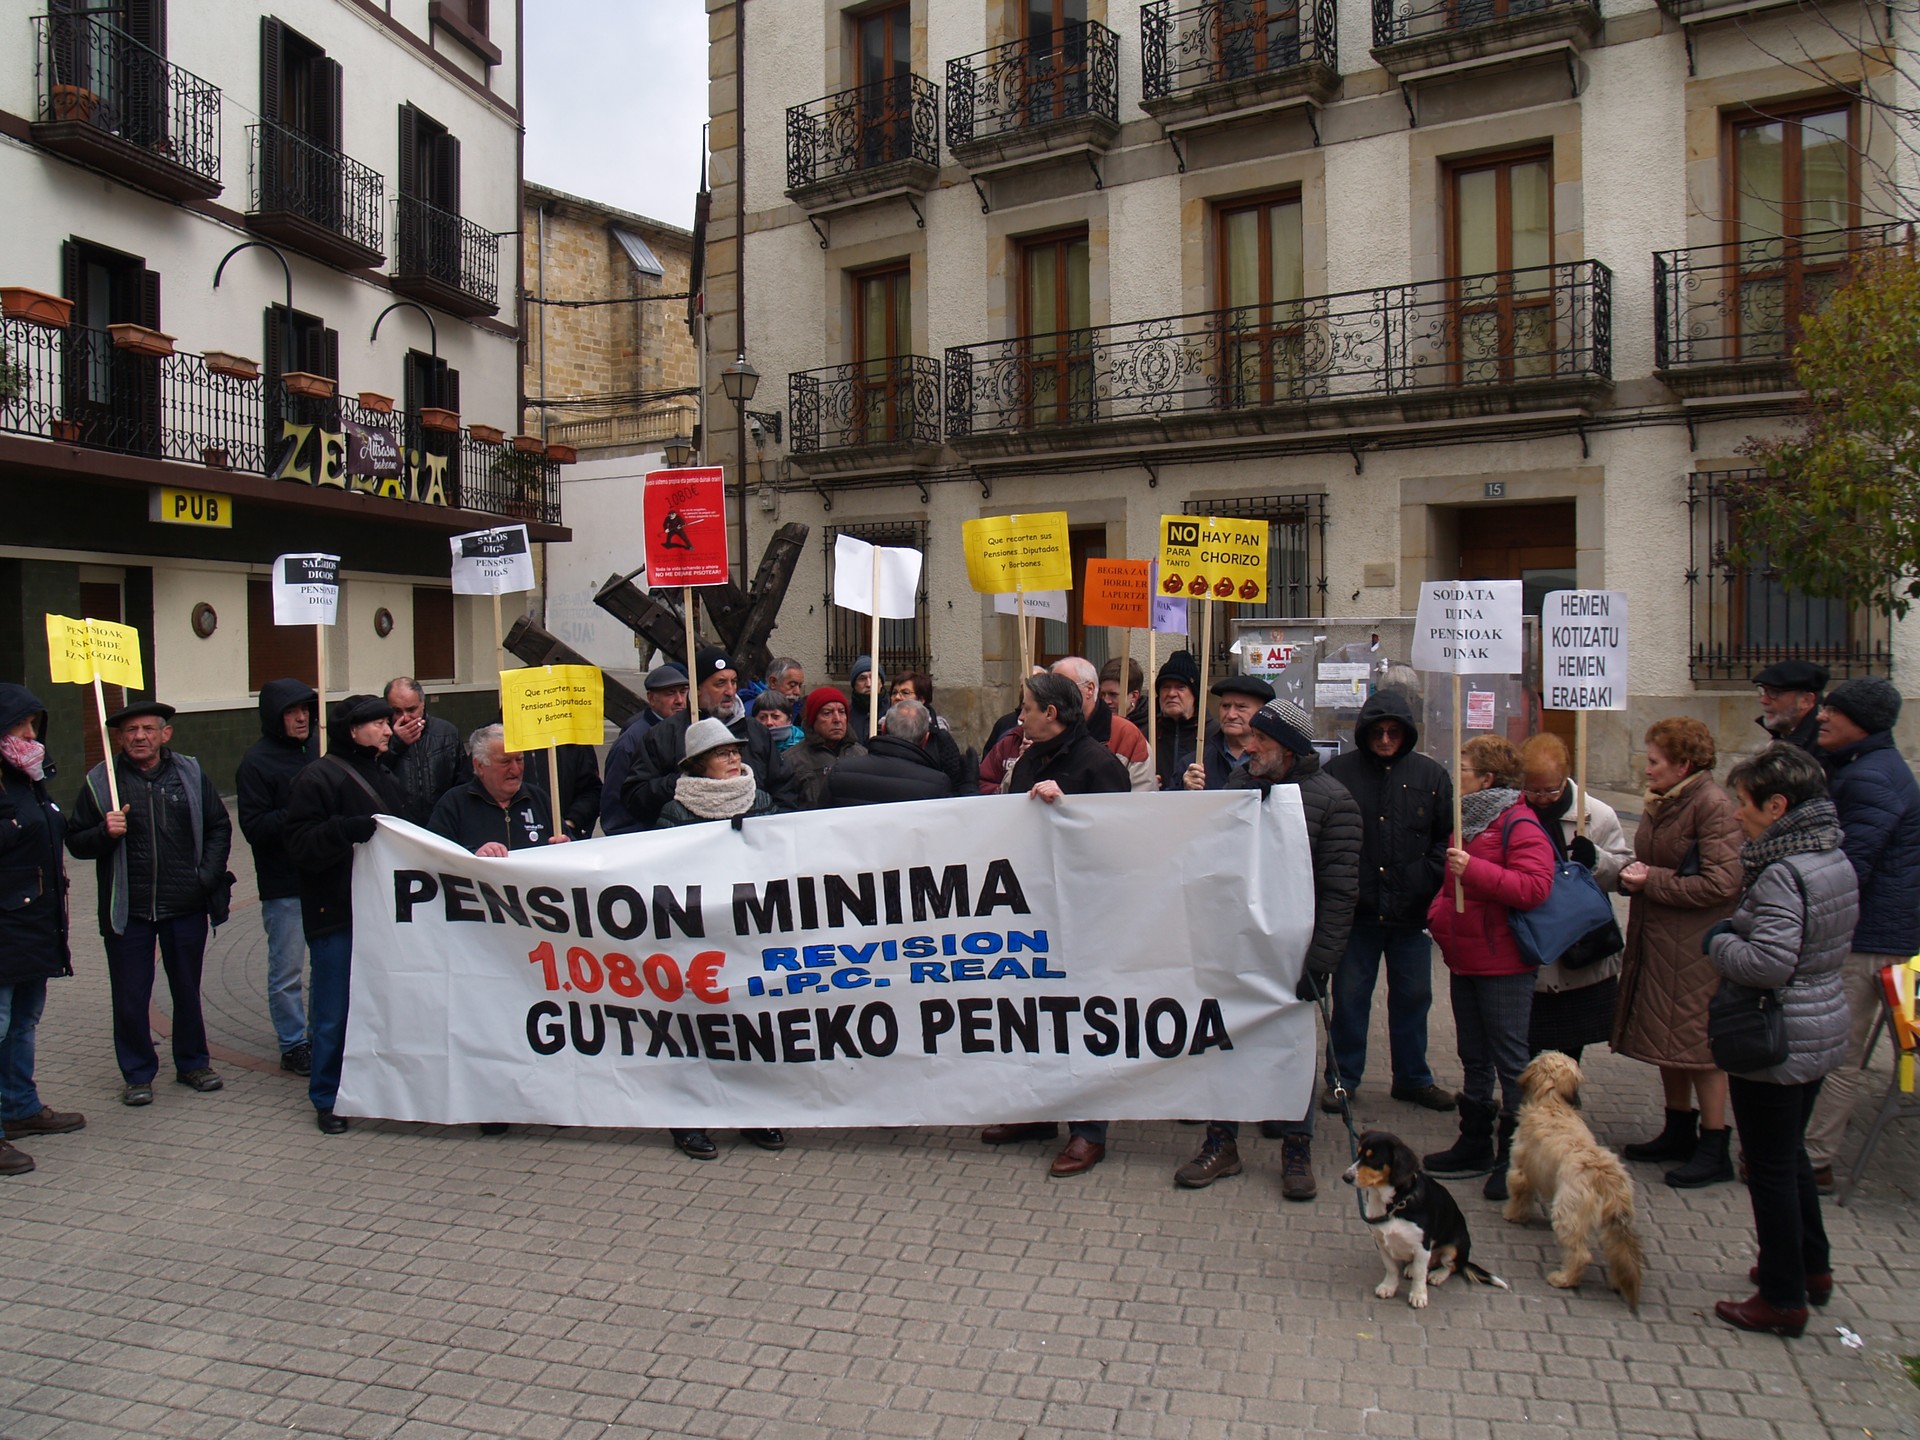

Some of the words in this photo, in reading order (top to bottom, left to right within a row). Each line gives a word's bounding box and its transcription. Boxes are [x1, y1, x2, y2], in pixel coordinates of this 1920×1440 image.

[359, 436, 396, 461] Altsasu
[665, 484, 700, 509] 1080€
[1489, 483, 1501, 496] 15
[175, 494, 219, 522] PUB
[988, 537, 1004, 545] Que
[1006, 534, 1038, 542] recorten
[1170, 525, 1197, 542] NO
[1202, 531, 1232, 544] HAY
[1235, 534, 1260, 547] PAN
[1166, 547, 1191, 557] PARA
[1200, 551, 1260, 567] CHORIZO
[1166, 559, 1190, 568] TANTO
[1097, 566, 1129, 574] BEGIRA
[1013, 598, 1050, 608] PNSIONES
[1433, 589, 1495, 600] SOLDATA
[1110, 603, 1143, 612] DIZUTE
[1561, 595, 1609, 616] HEMEN
[66, 625, 123, 639] PENTSIOAK
[1552, 627, 1619, 648] KOTIZATU
[71, 638, 121, 650] ESKUBIDE
[65, 650, 77, 660] EZ
[78, 651, 131, 666] NEGOZIOA
[1558, 656, 1605, 677] HEMEN
[525, 689, 541, 697] Que
[1552, 687, 1612, 708] ERABAKI
[537, 717, 542, 725] y
[394, 869, 706, 940] PENSION
[732, 858, 1031, 936] MINIMA
[762, 930, 1050, 971] REVISION
[528, 941, 730, 1004] 1.080€
[748, 966, 891, 997] I.P.C.
[910, 958, 1066, 983] REAL
[526, 1000, 899, 1063] GUTXIENEKO
[920, 996, 1234, 1059] PENTSIOA
